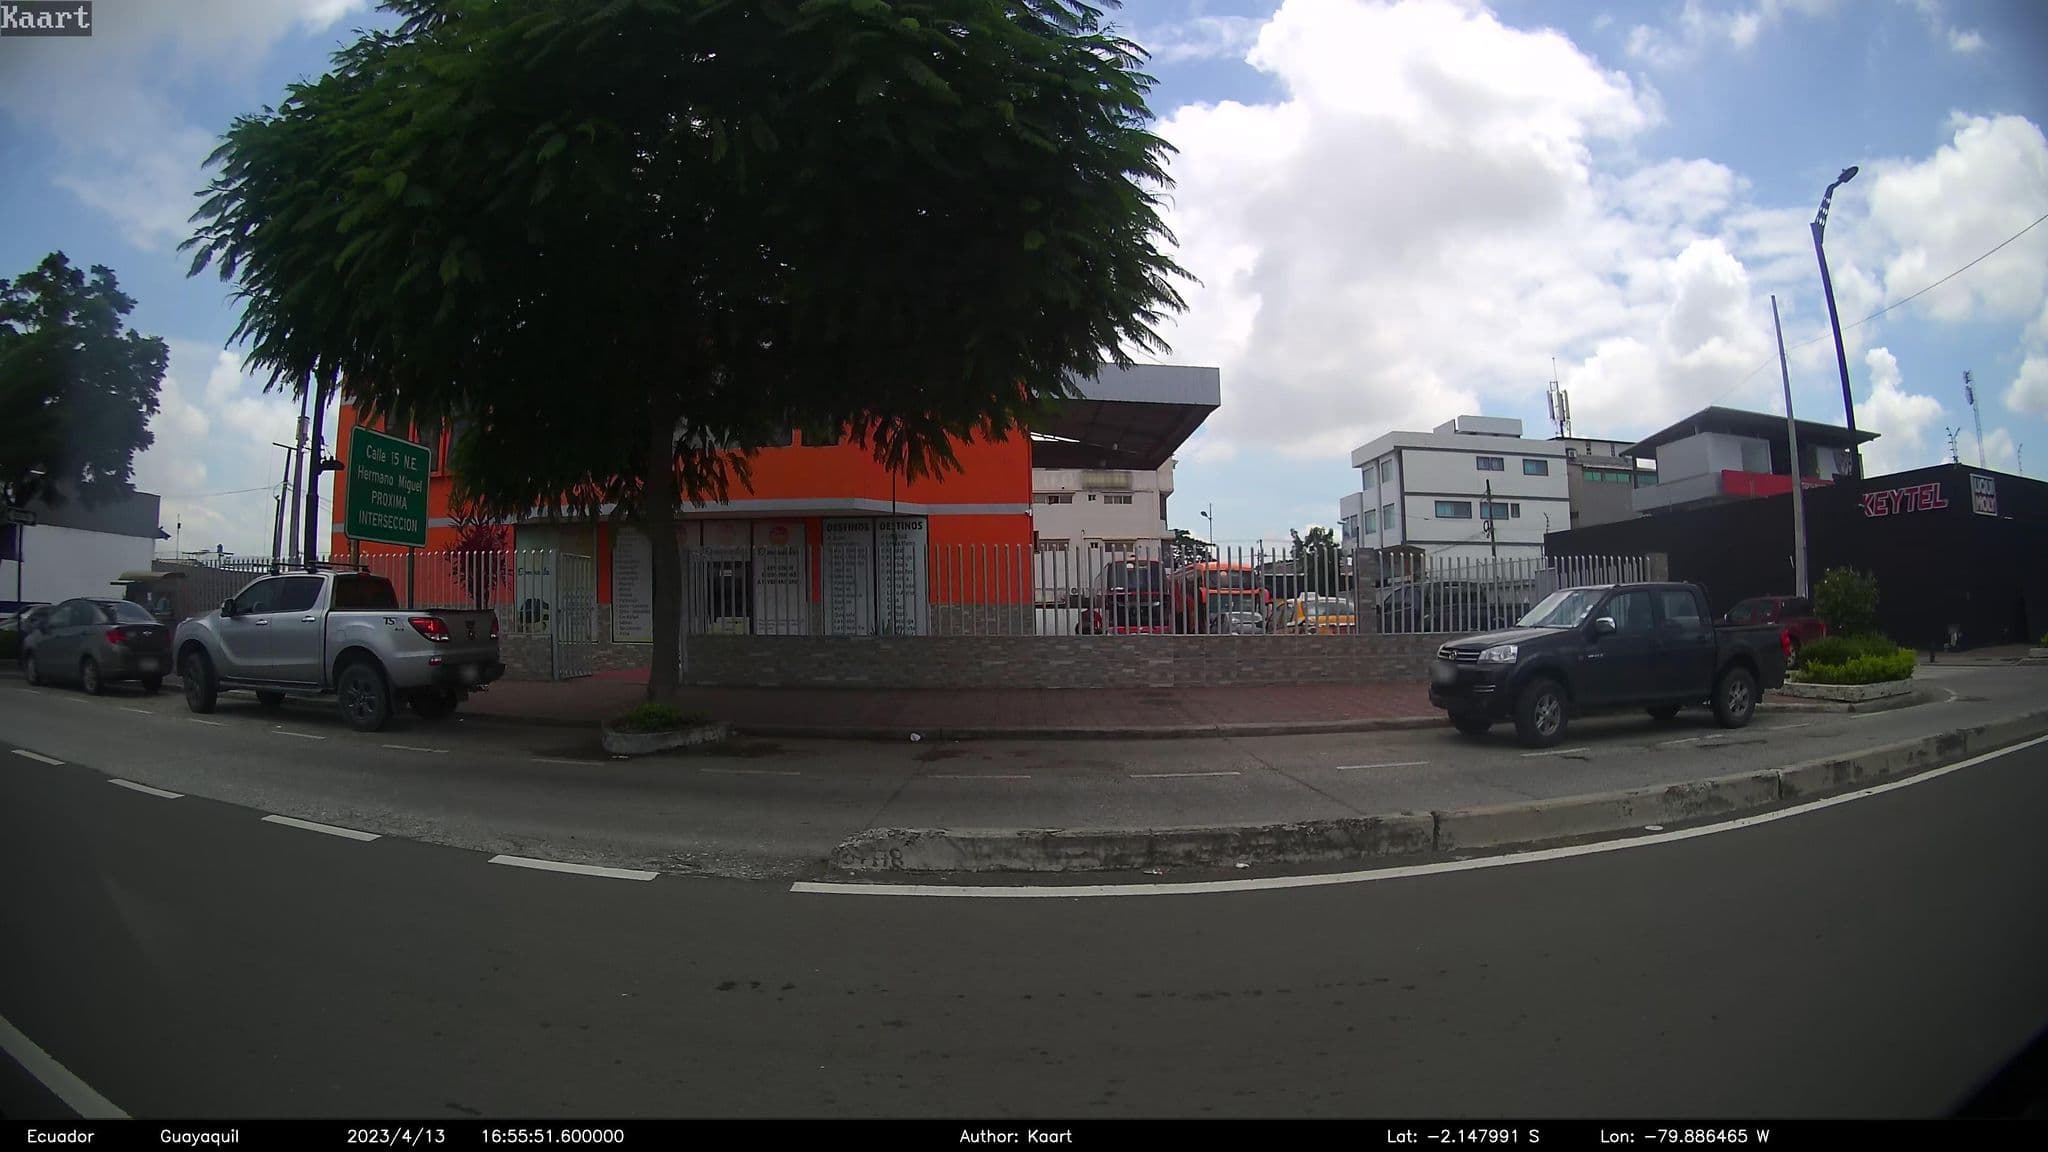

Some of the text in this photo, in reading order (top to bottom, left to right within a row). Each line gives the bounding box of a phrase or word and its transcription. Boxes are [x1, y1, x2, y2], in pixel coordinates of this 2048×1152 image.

[366, 444, 386, 462] Calle
[357, 465, 423, 494] Hermano Miguel
[371, 490, 408, 510] PROXIMA
[1862, 482, 1948, 517] KEYTEL
[358, 510, 418, 532] INTERSECCION
